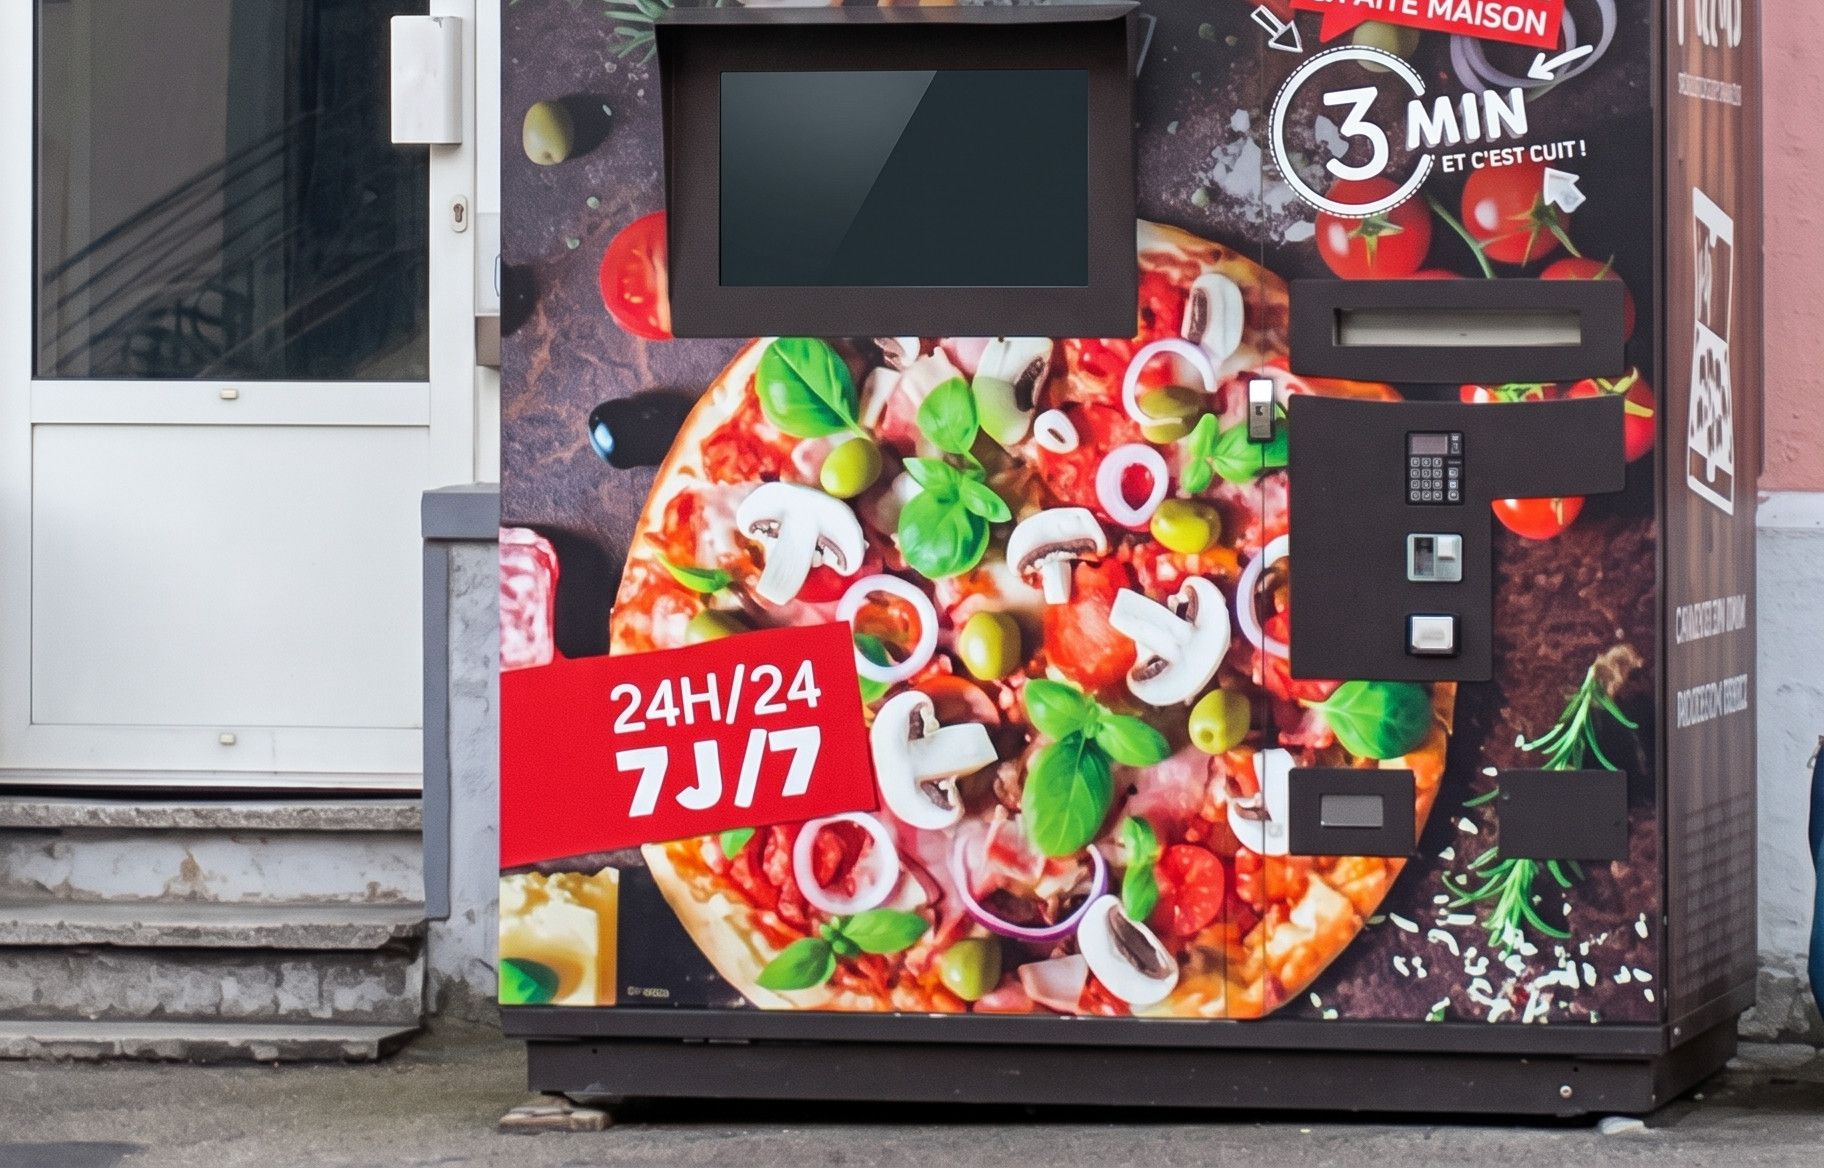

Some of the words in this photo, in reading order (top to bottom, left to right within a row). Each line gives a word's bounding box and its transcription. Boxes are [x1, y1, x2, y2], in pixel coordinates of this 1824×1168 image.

[1323, 86, 1389, 181] 3
[1405, 87, 1529, 152] MIN
[1441, 151, 1466, 173] ET
[1471, 146, 1525, 169] C'EST
[1529, 140, 1576, 162] CUIT
[609, 659, 822, 734] 24H/24
[615, 726, 822, 818] 7J/7
